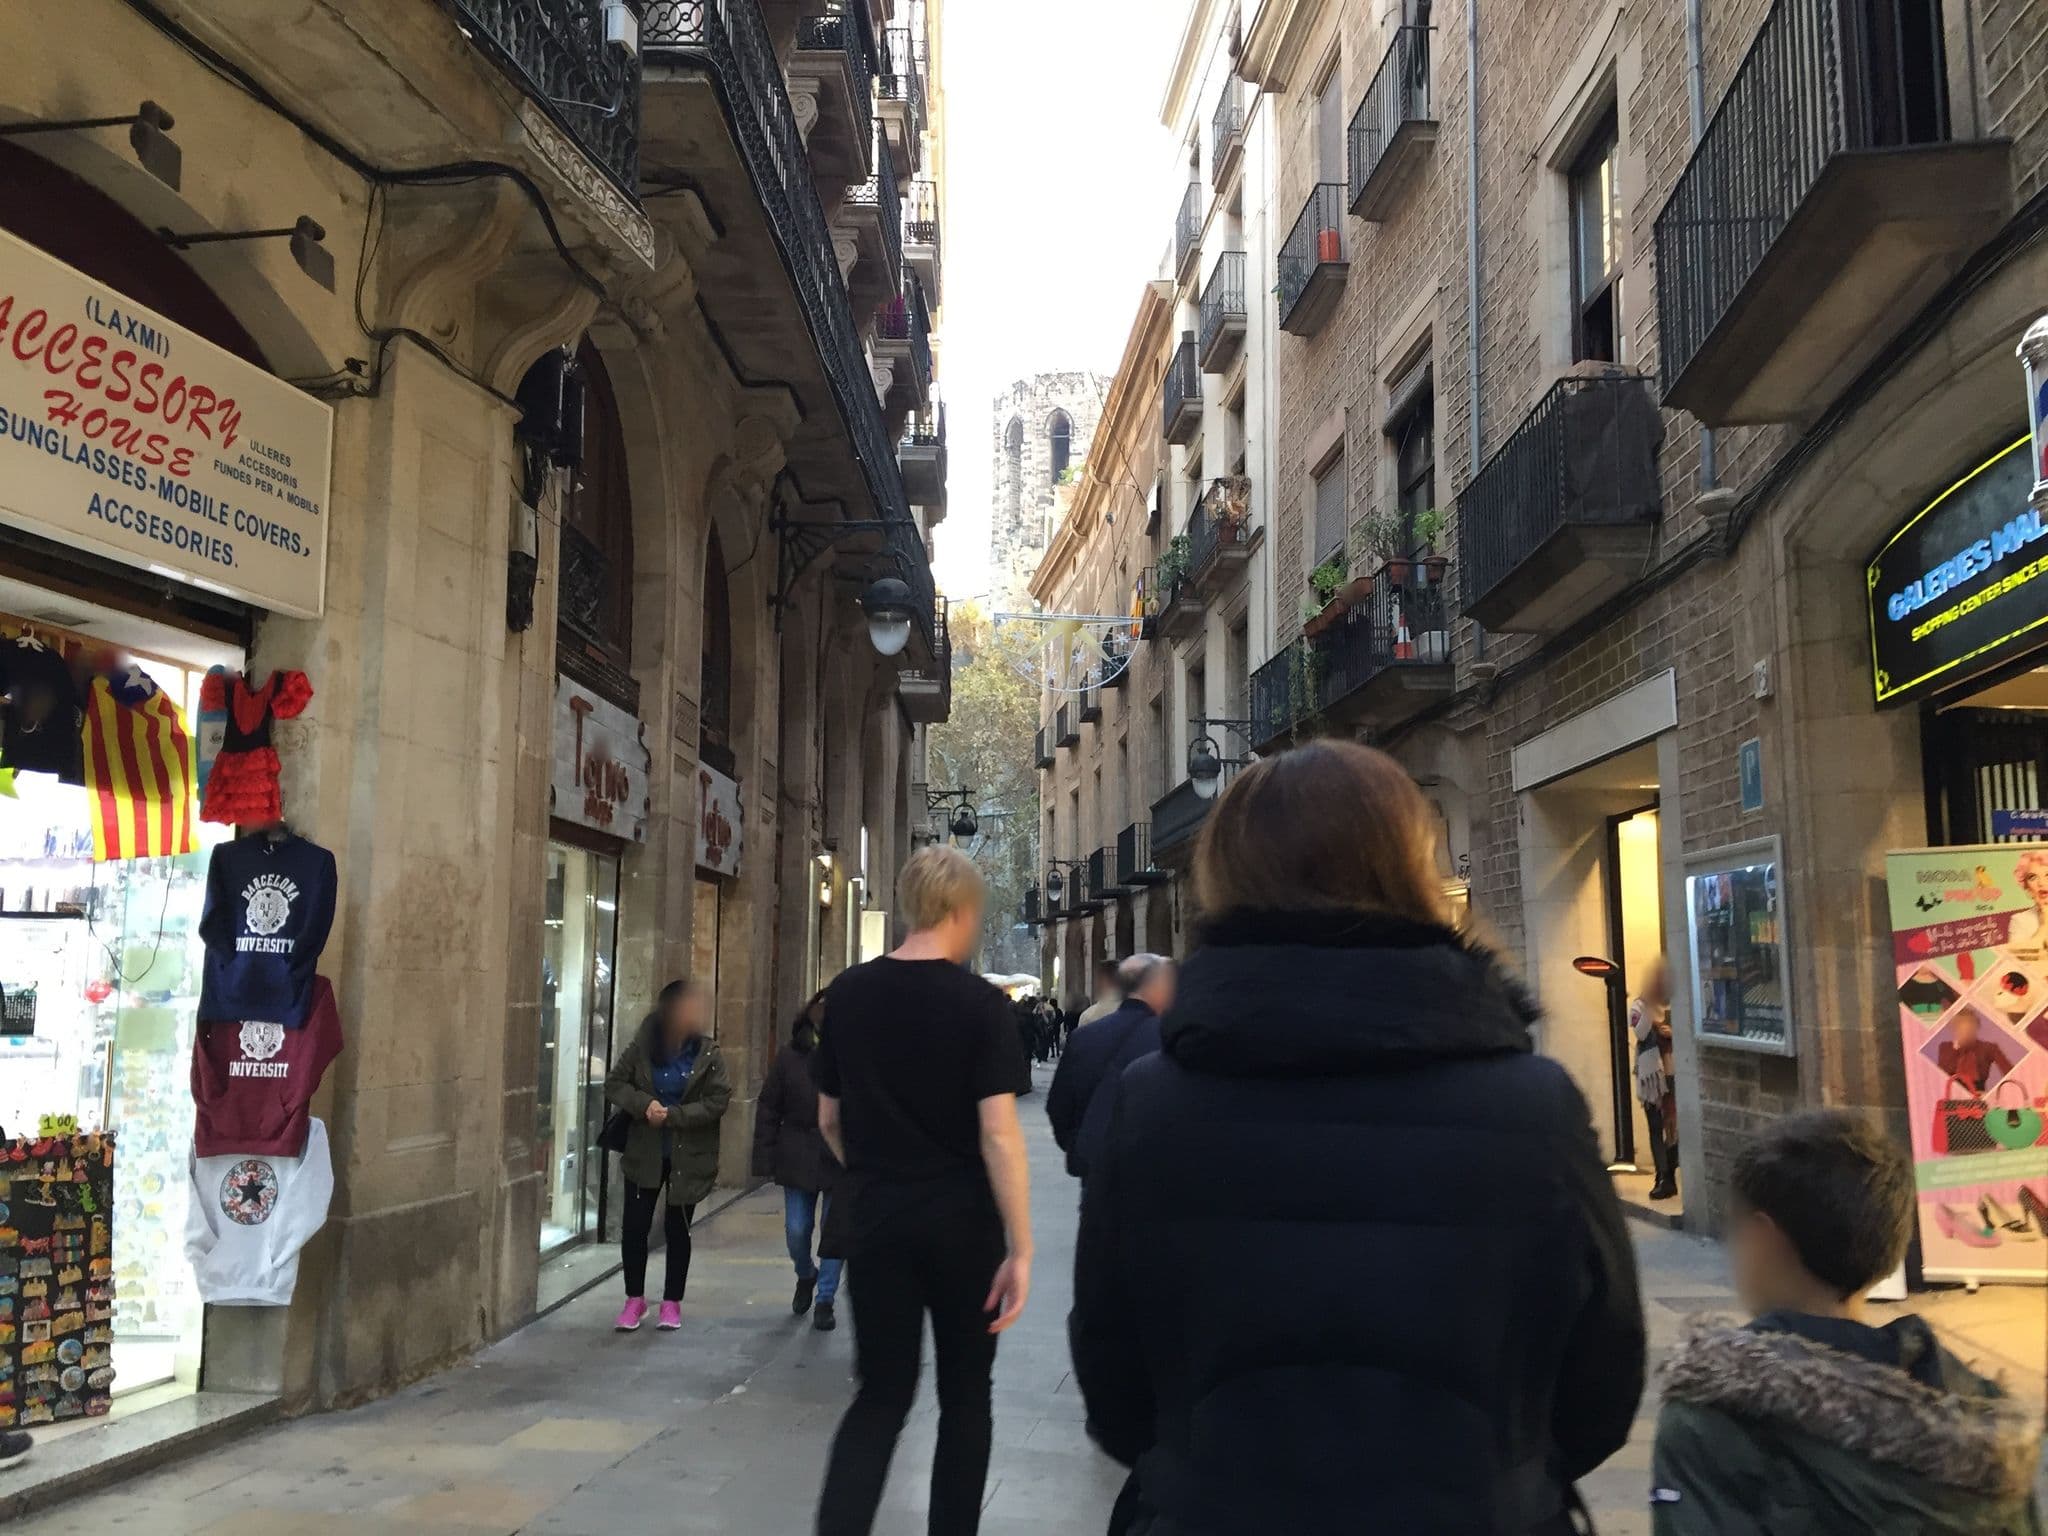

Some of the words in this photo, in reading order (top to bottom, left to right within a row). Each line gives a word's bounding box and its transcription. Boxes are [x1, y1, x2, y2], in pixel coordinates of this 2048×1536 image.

[86, 295, 170, 358] (LAXMI)
[44, 390, 195, 477] HOUSE
[249, 440, 292, 468] ULLERES
[213, 459, 252, 485] FUNDES
[254, 478, 273, 494] PER
[277, 489, 284, 500] A
[286, 492, 320, 515] MOBILS
[239, 454, 298, 489] ACCESSORIS
[88, 493, 239, 568] ACCSESORIES.
[234, 509, 310, 557] COVERS,
[1888, 539, 1993, 622] GALERIES
[1911, 605, 1960, 643] SHOPPING
[1958, 582, 2003, 617] CENTER
[2002, 561, 2039, 594] SINCE
[241, 873, 300, 902] BARCELONA
